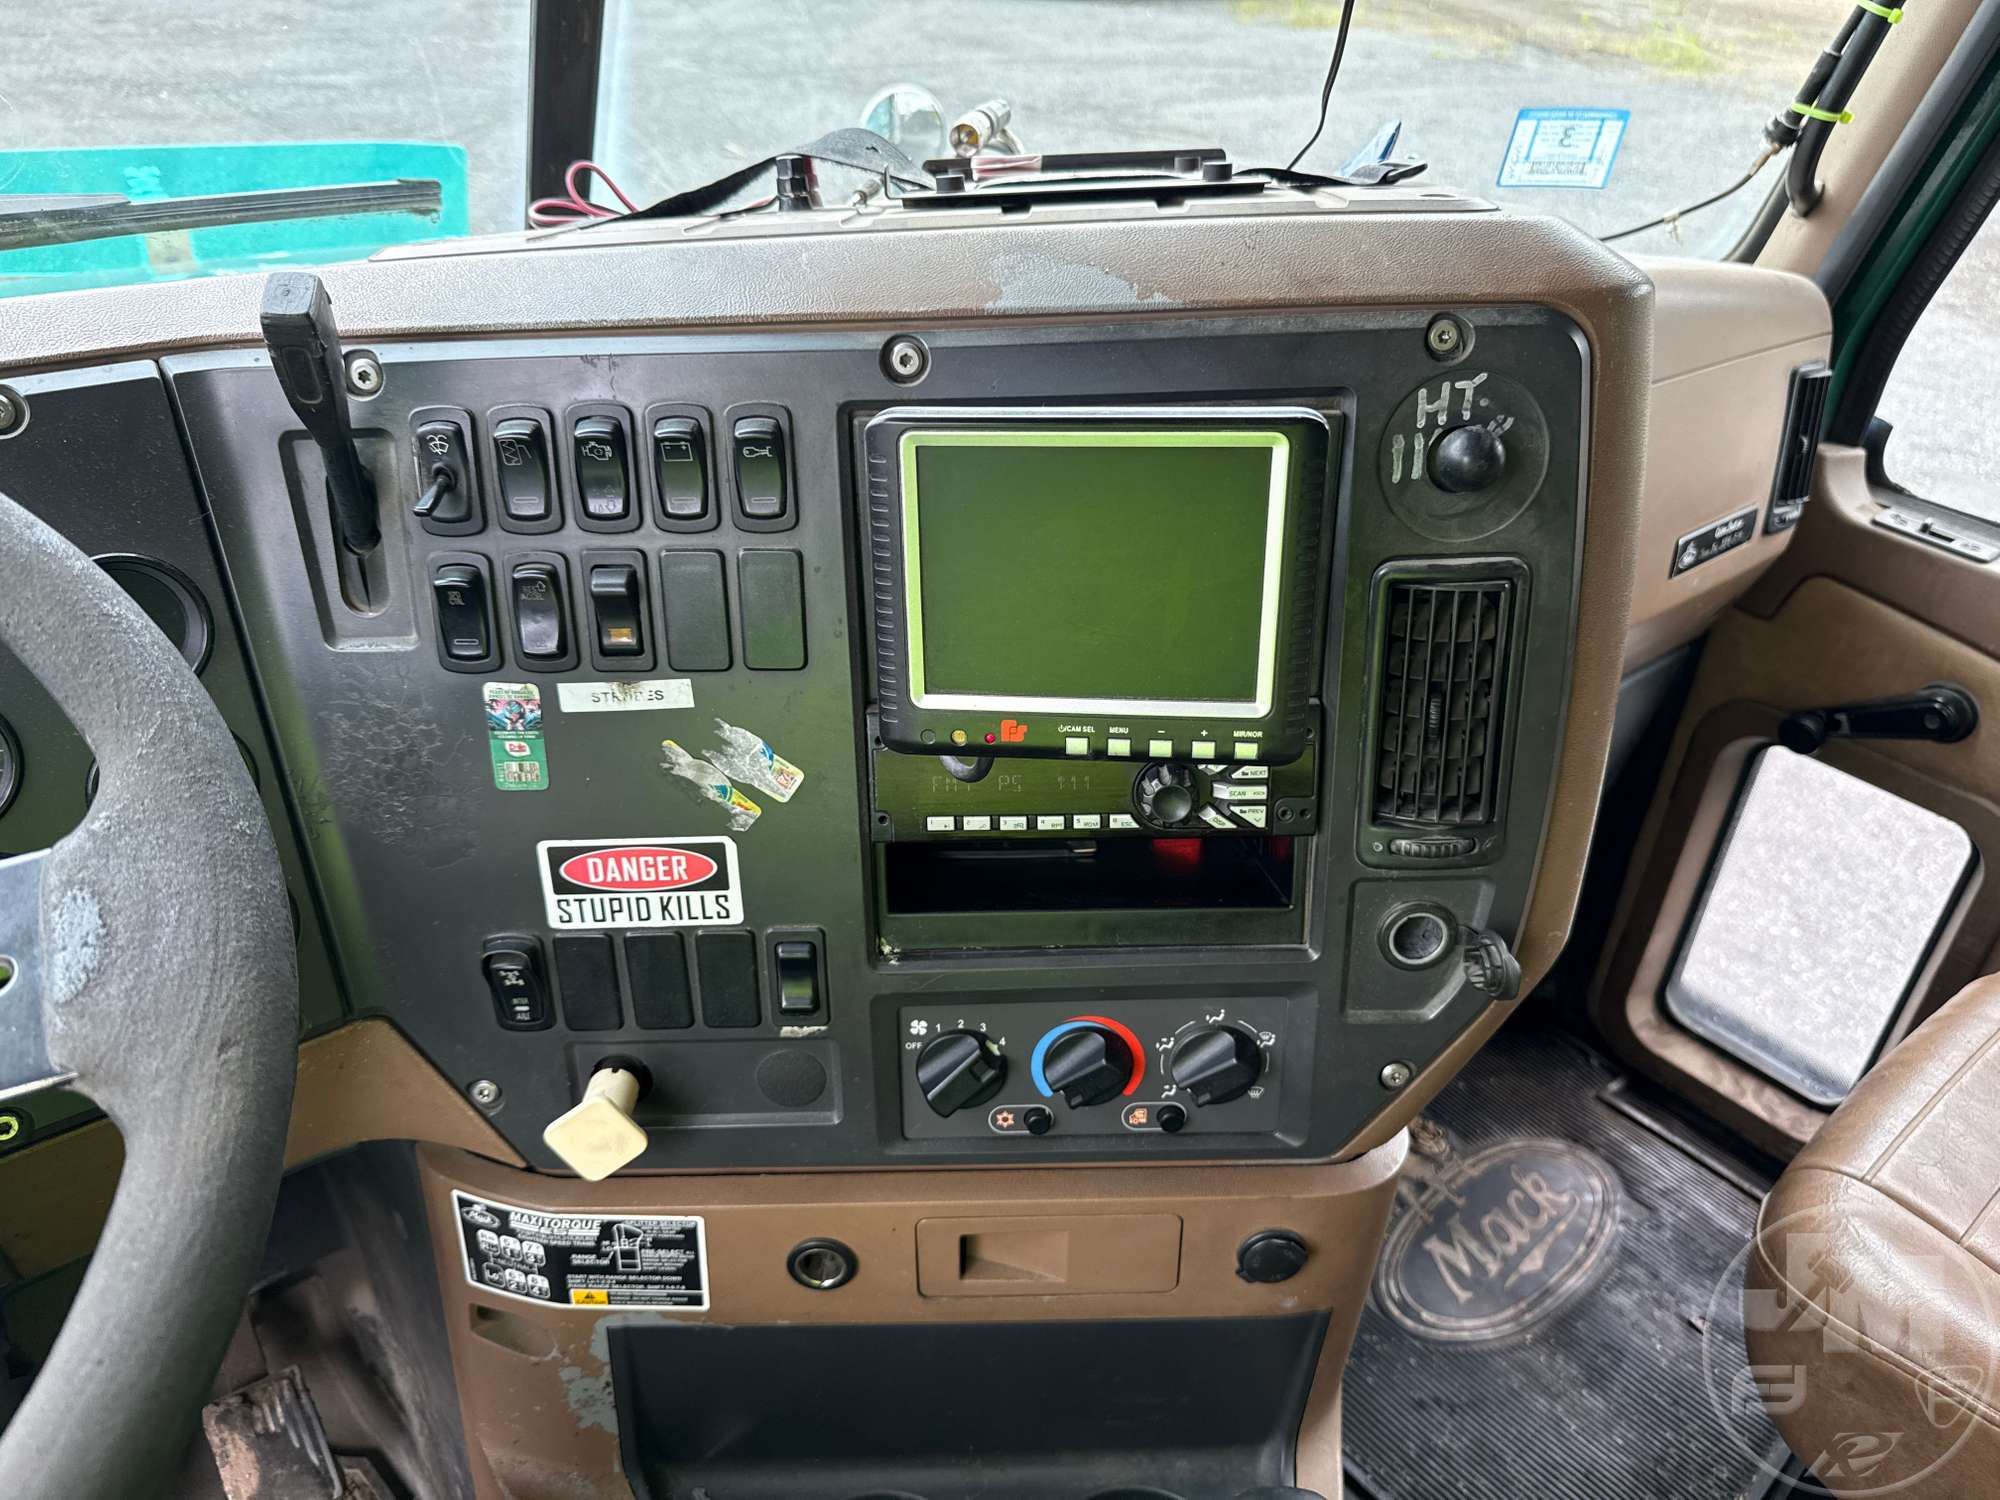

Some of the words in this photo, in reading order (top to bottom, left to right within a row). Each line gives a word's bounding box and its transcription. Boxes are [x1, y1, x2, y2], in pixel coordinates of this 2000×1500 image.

[1082, 726, 1096, 734] SEL
[1109, 726, 1129, 735] MENU
[1233, 729, 1263, 738] MIR/NOR
[586, 855, 689, 883] DANGER
[557, 896, 652, 924] STUPID
[659, 894, 731, 921] KILLS
[957, 1019, 965, 1030] 2
[980, 1022, 987, 1033] 3
[905, 1041, 923, 1050] OFF
[999, 1036, 1006, 1047] 4
[510, 1211, 602, 1230] MAXITORQUE
[1422, 1164, 1571, 1304] Mack
